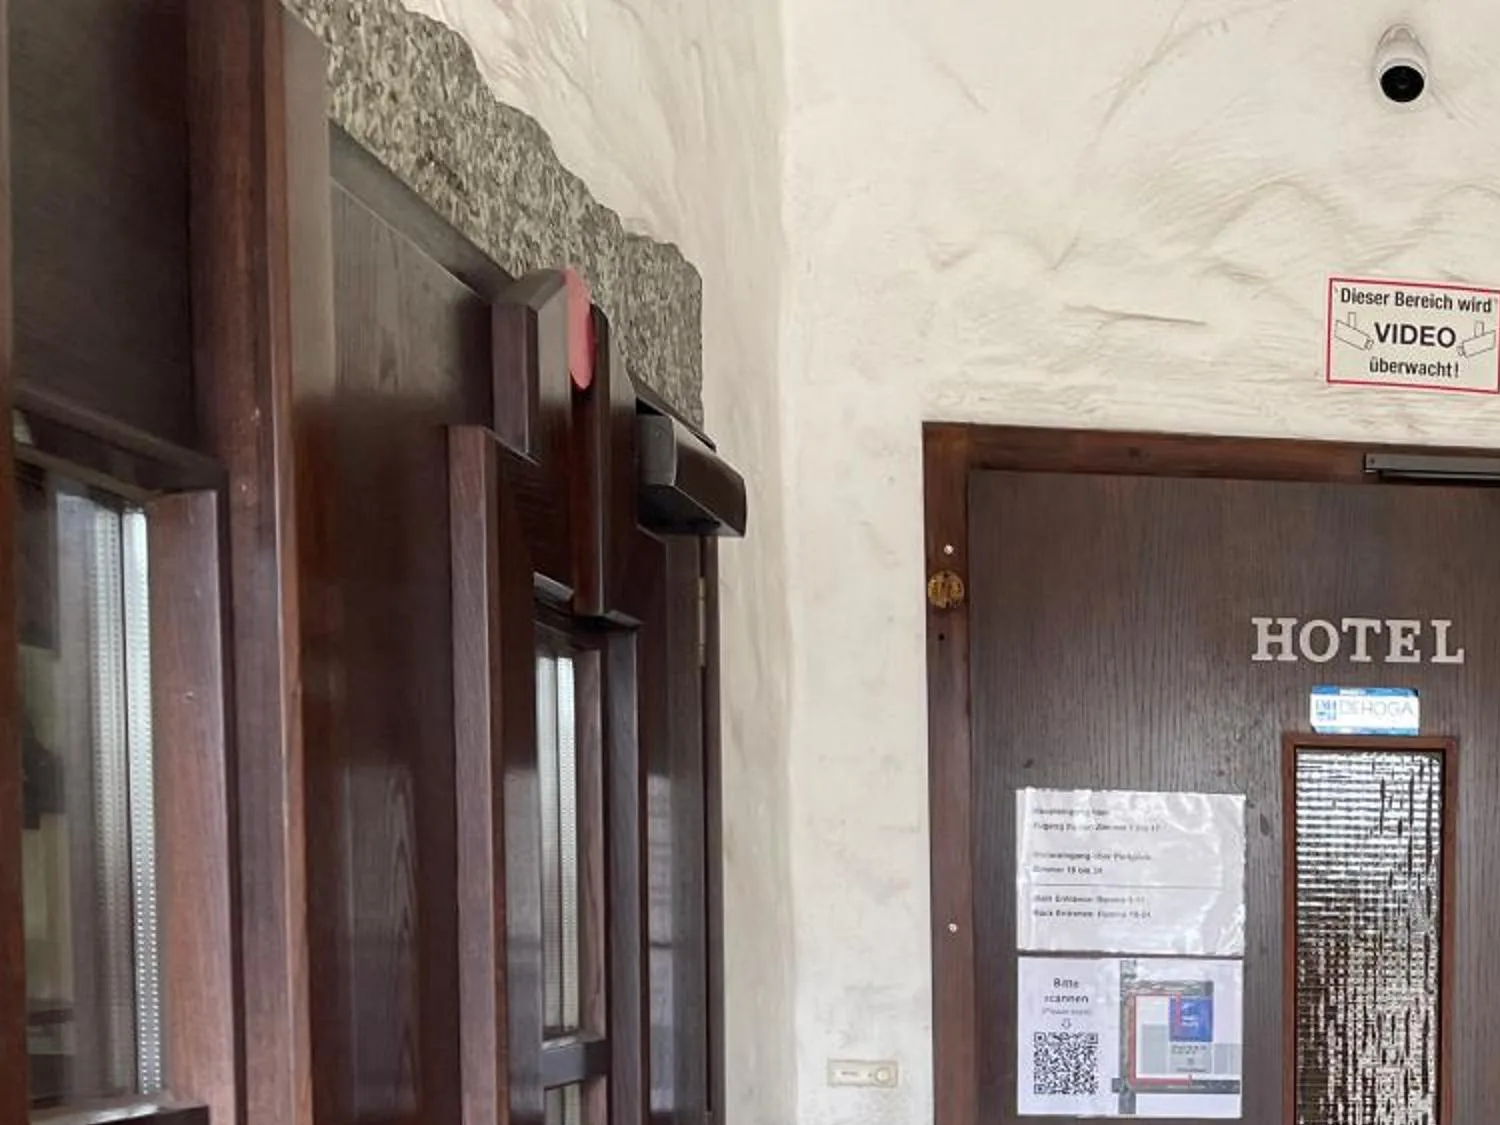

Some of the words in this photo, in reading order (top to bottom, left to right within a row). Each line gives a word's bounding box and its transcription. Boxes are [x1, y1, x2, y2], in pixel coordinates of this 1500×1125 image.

[1340, 287, 1389, 306] Dieser
[1394, 291, 1453, 311] Bereich
[1457, 296, 1492, 313] wird
[1374, 322, 1457, 348] VIDEO
[1251, 617, 1465, 664] HOTEL
[1339, 699, 1414, 717] DEHOGA
[1053, 977, 1080, 989] Bitte
